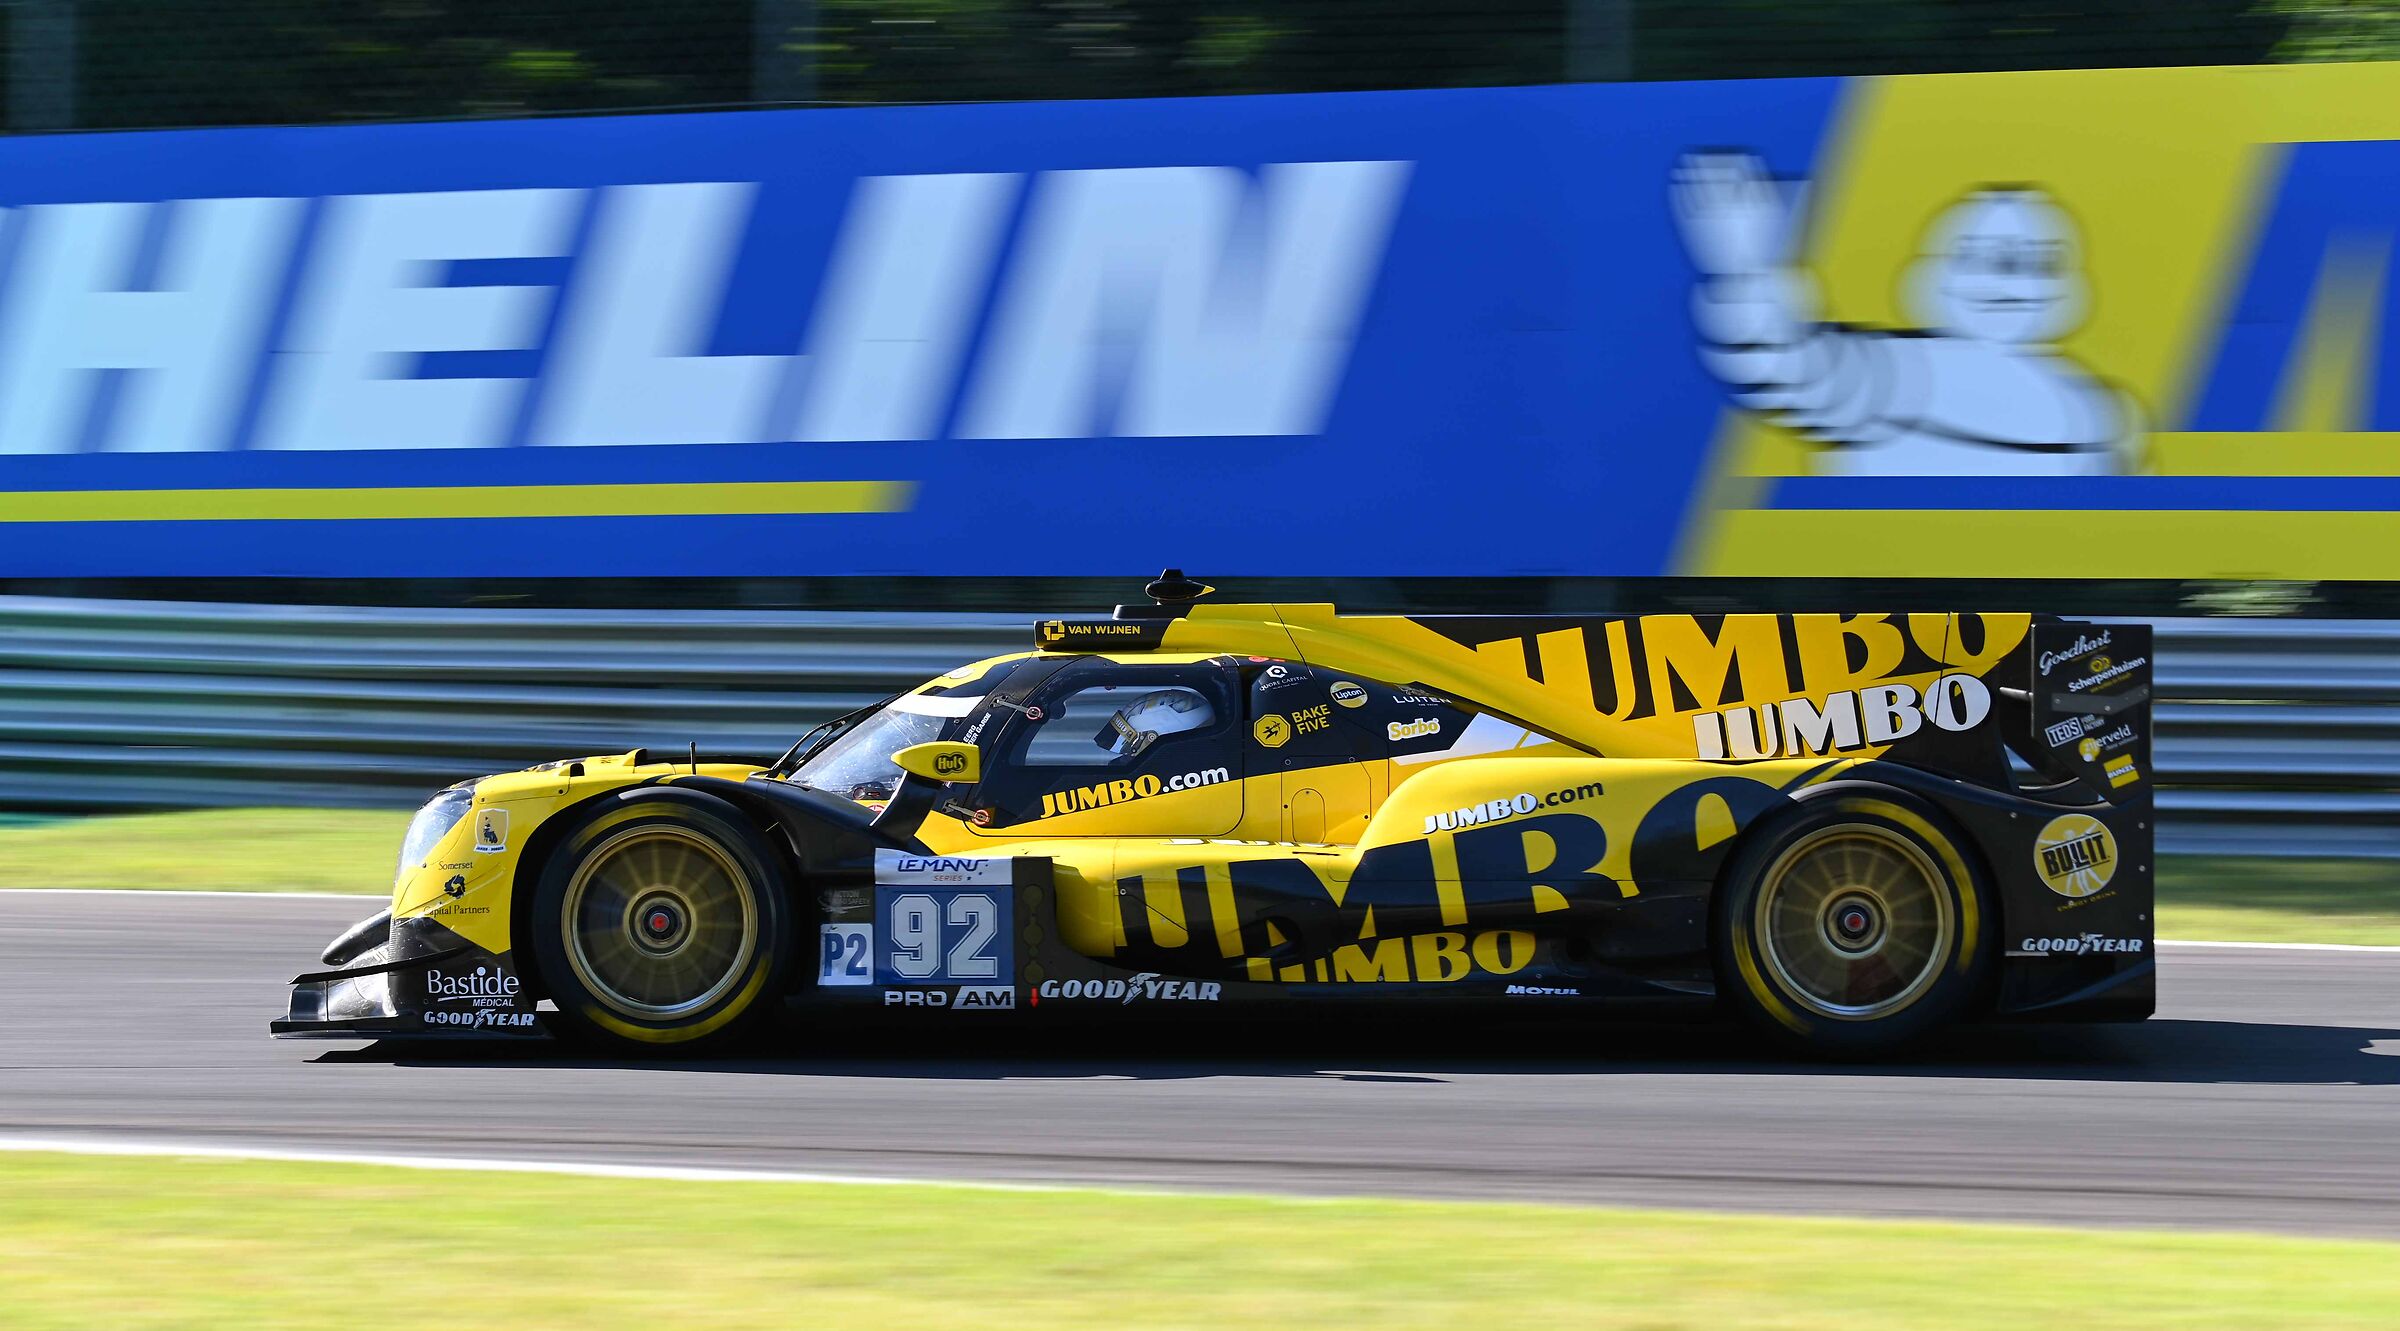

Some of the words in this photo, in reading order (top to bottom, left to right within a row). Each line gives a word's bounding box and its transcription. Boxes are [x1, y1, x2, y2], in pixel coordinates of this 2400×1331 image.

[0, 160, 1415, 456] HELIN
[1067, 625, 1092, 635] VAN
[1094, 625, 1141, 635] WIJNEN
[2039, 628, 2112, 676] Goodhart
[1335, 688, 1363, 700] Lipton
[975, 712, 992, 734] GARDE
[1291, 703, 1331, 723] BAKE
[1692, 673, 1992, 759] JUMBO
[1296, 716, 1330, 735] FIVE
[1040, 766, 1230, 819] JUMBO.com
[1422, 782, 1605, 835] JUMBO.com
[438, 861, 473, 870] Somerset
[453, 904, 490, 915] Partners
[891, 893, 998, 979] 92
[823, 932, 868, 977] P2
[427, 966, 520, 995] Bastide
[1504, 984, 1581, 996] MOTUL
[884, 990, 948, 1007] PRO
[961, 990, 1012, 1006] AM
